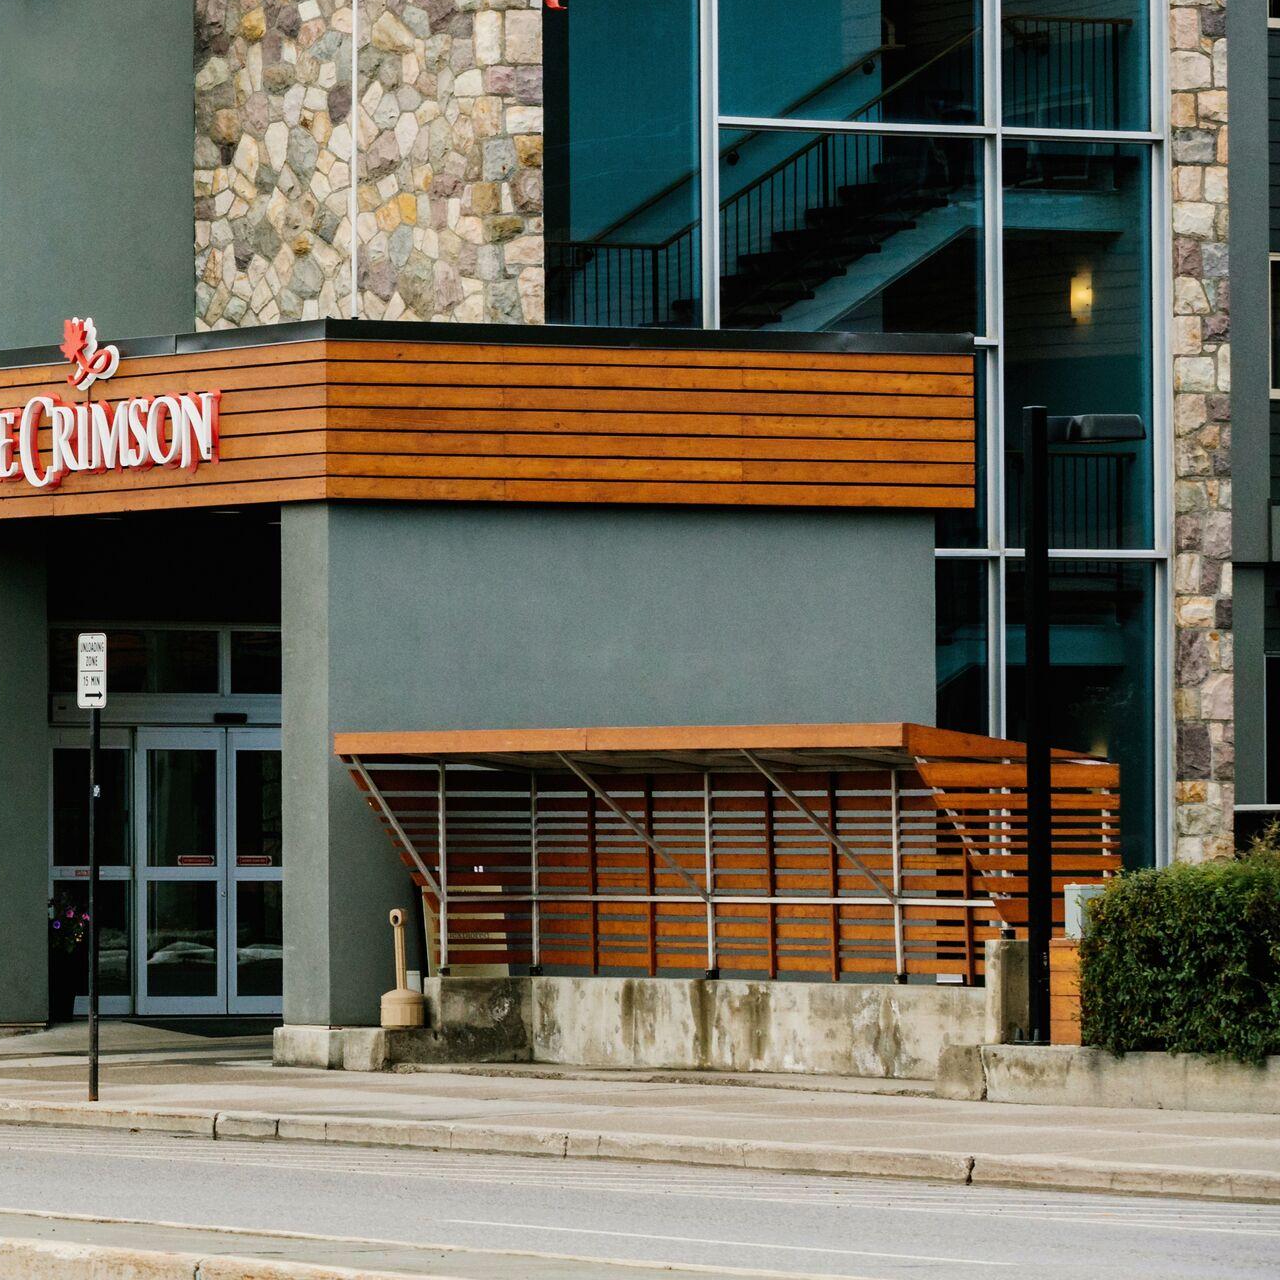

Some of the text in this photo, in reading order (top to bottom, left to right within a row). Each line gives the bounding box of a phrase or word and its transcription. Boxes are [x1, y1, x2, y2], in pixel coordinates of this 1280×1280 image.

[19, 392, 221, 489] CRIMSON
[85, 656, 98, 667] ZONE
[83, 675, 101, 687] 15 MIN
